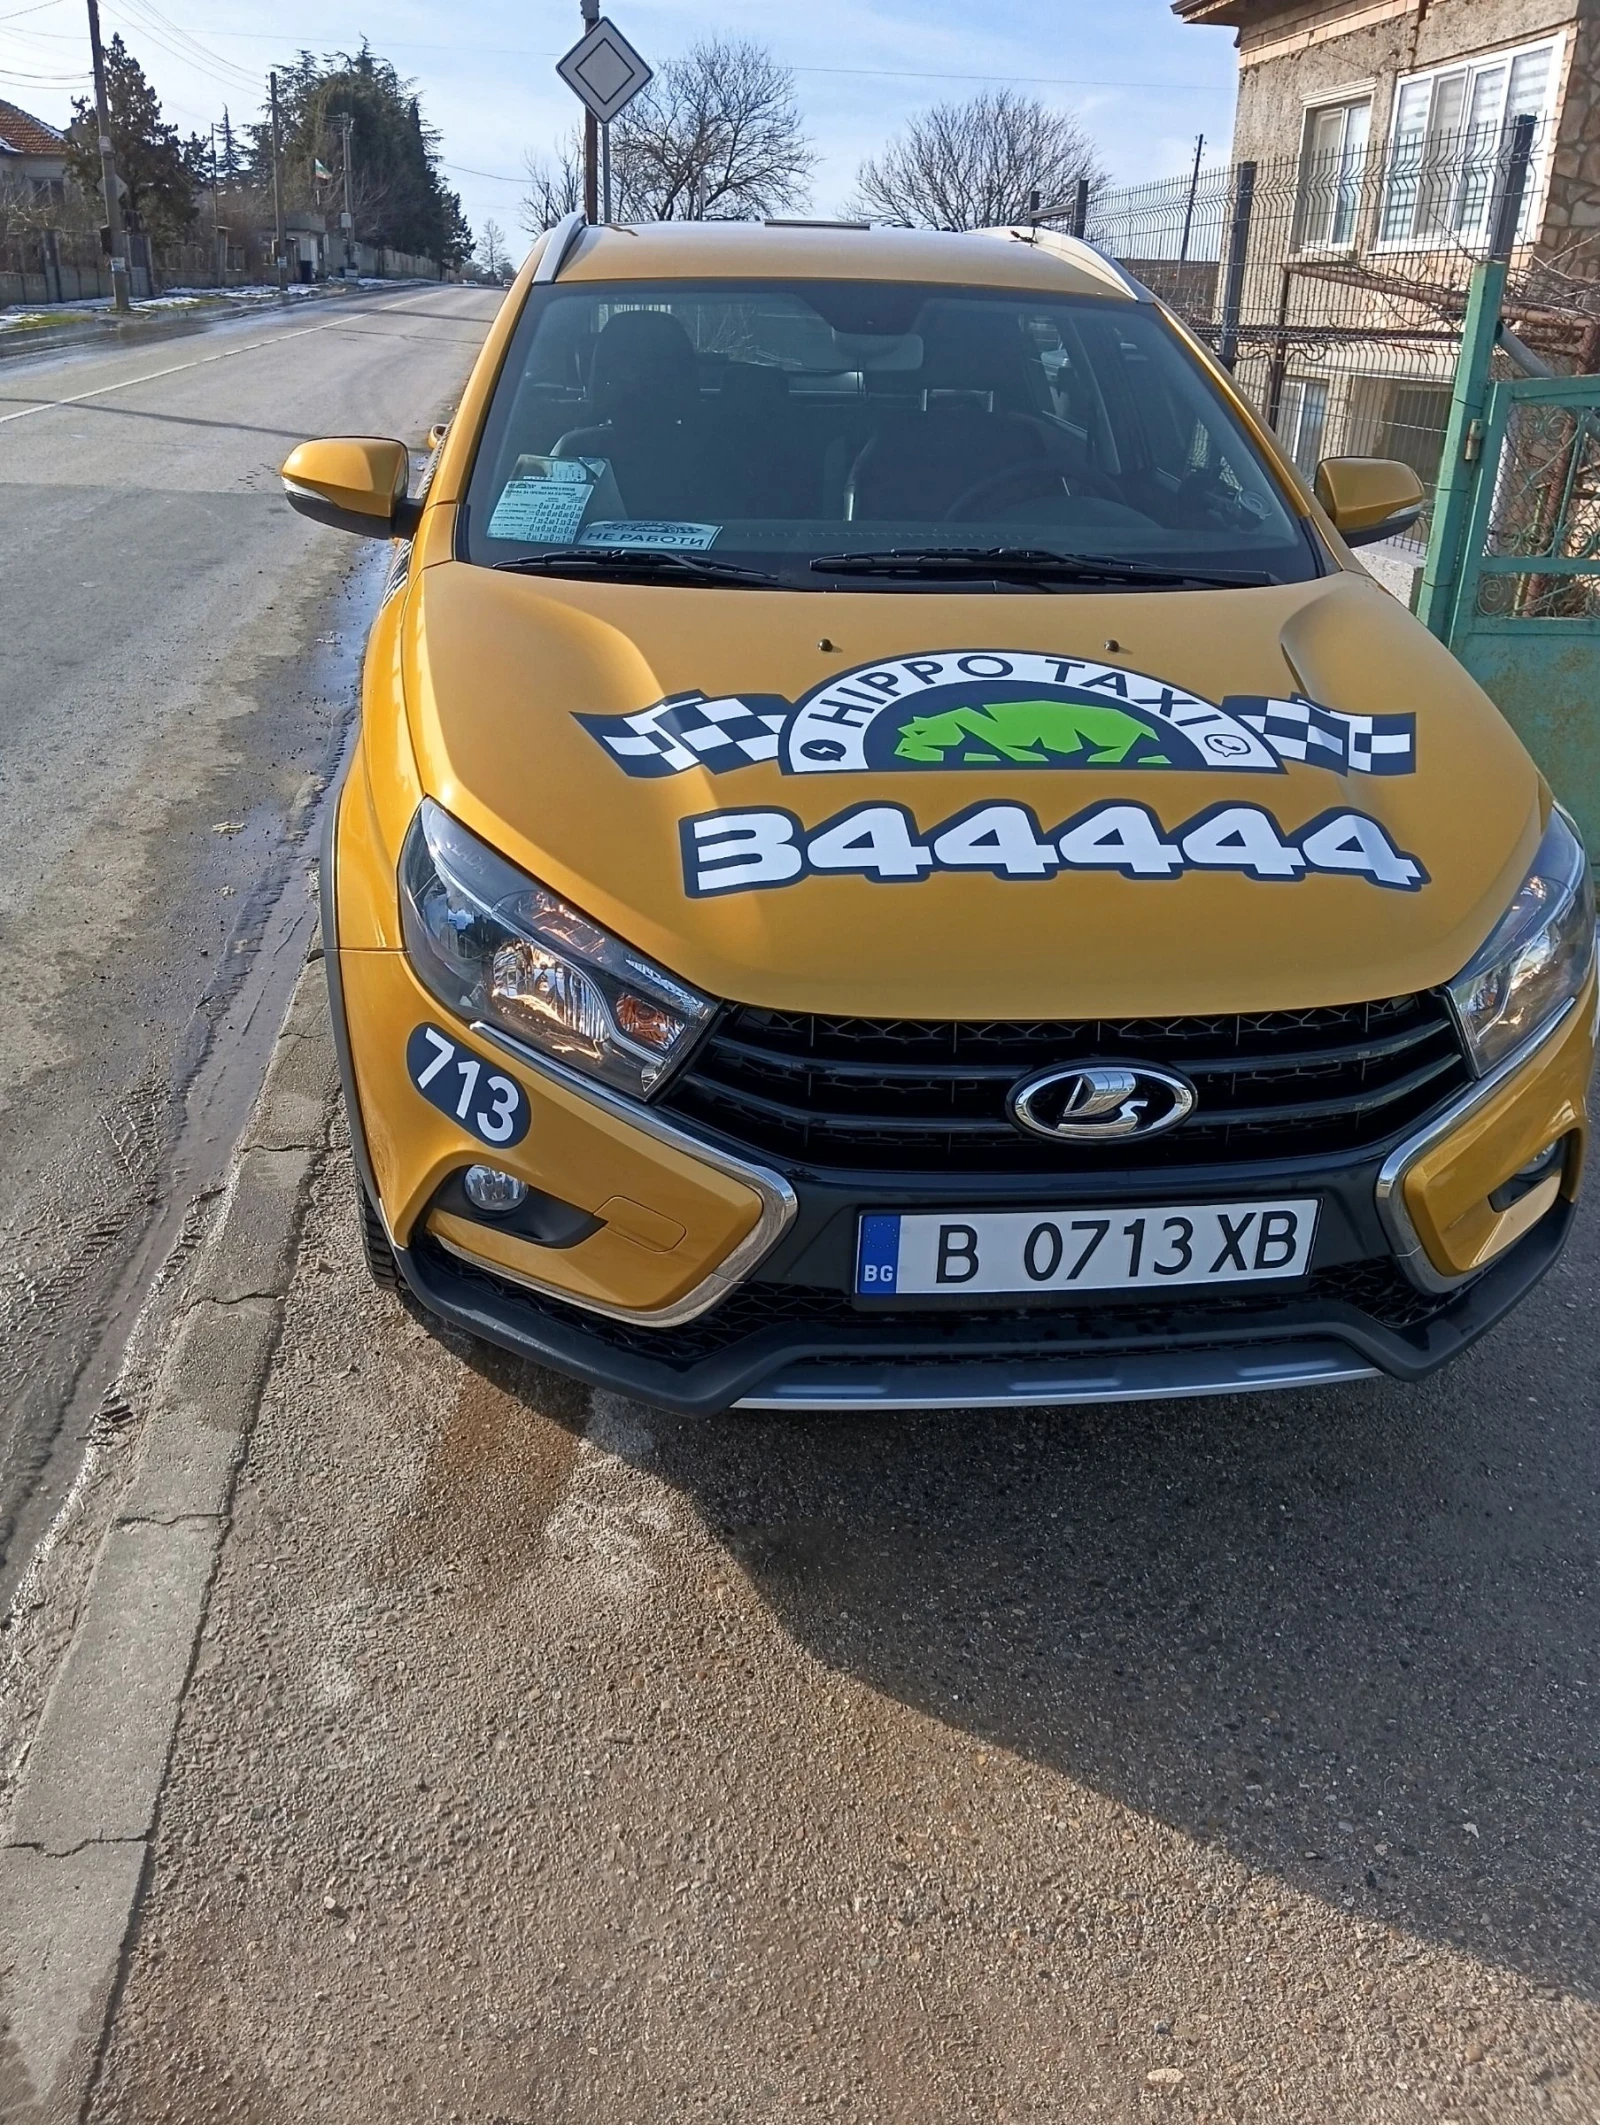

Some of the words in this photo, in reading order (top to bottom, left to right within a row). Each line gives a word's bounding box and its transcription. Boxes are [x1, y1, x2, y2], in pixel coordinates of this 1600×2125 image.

[587, 533, 615, 541] НЕ
[622, 534, 705, 546] РАБОТИ
[807, 655, 1014, 728] HIPPO
[1044, 658, 1223, 728] TAXI
[690, 803, 1425, 894] 344444
[417, 1027, 519, 1142] 713
[863, 1264, 893, 1283] BG
[935, 1223, 979, 1284] B
[1023, 1216, 1194, 1282] 0713
[1208, 1209, 1299, 1274] XB
